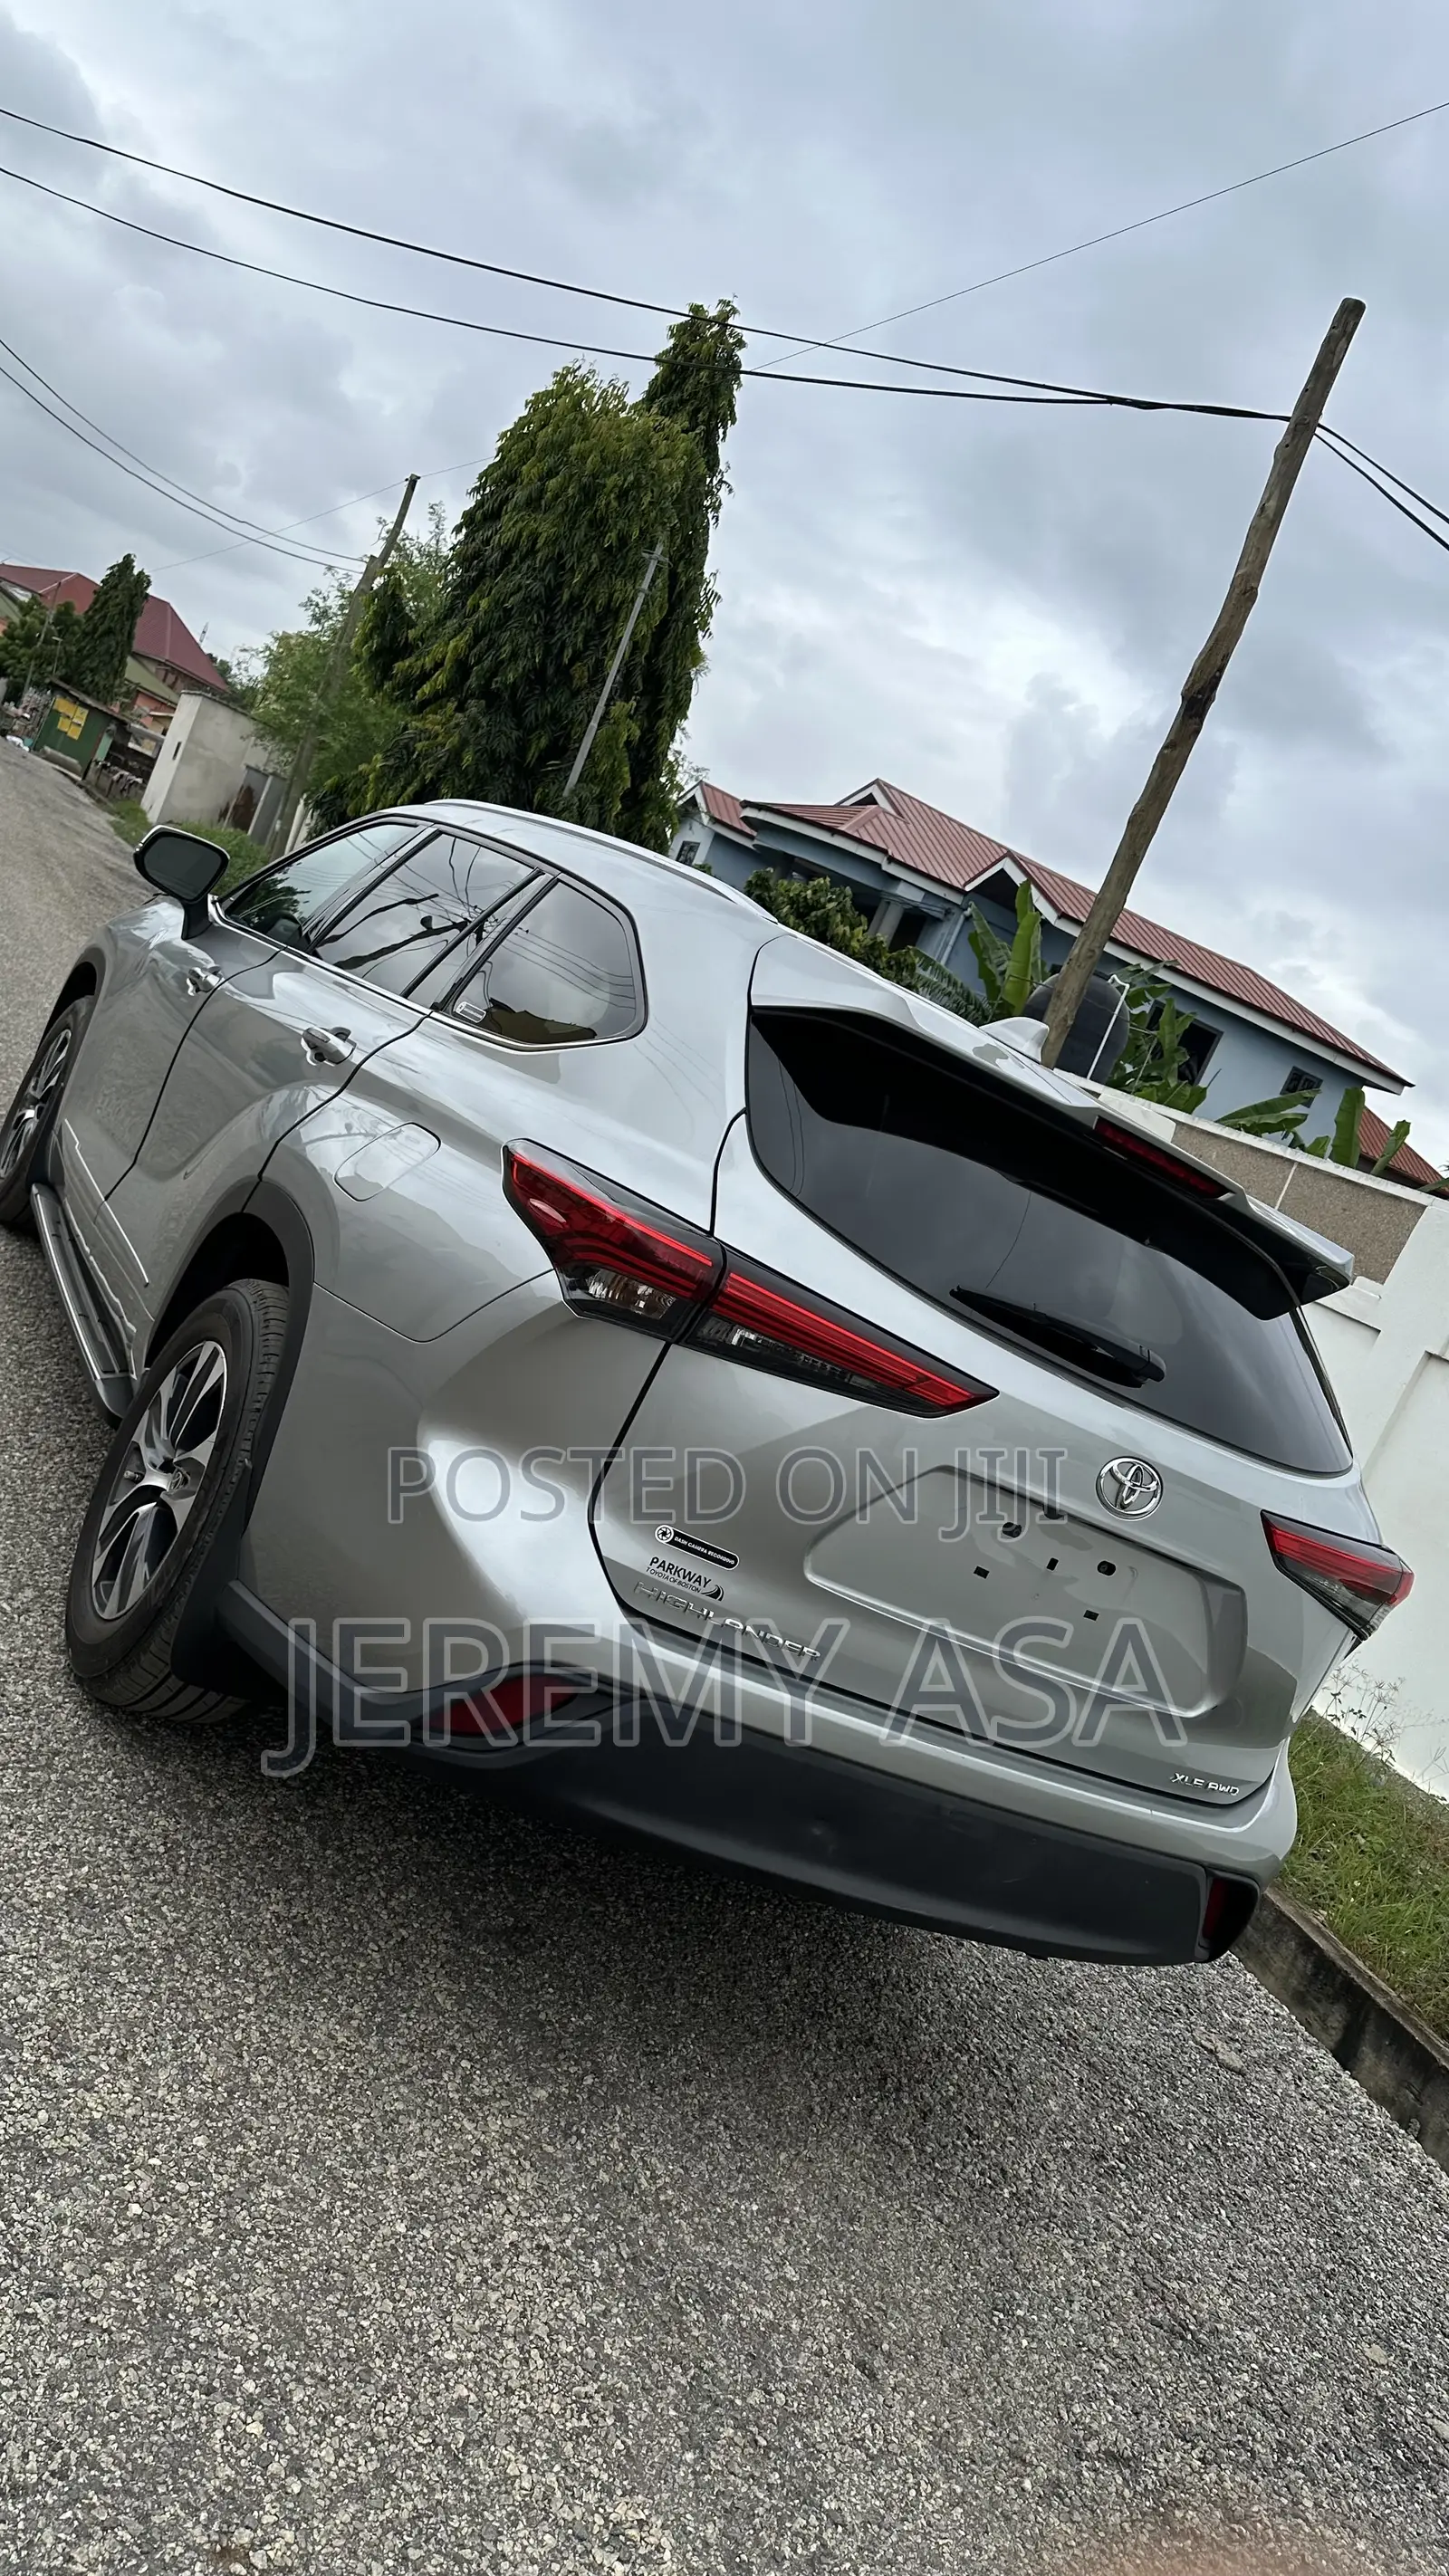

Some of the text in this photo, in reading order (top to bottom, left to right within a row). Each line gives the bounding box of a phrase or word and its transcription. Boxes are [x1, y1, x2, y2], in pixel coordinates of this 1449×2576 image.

[674, 1536, 687, 1546] DASH
[688, 1542, 707, 1554] CAMERA
[646, 1566, 669, 1581] TOYOTA
[677, 1580, 701, 1594] BOSTON
[649, 1556, 712, 1588] PARKWAY
[634, 1580, 821, 1661] HIGHLANDER
[1171, 1772, 1240, 1796] XLE AWD
